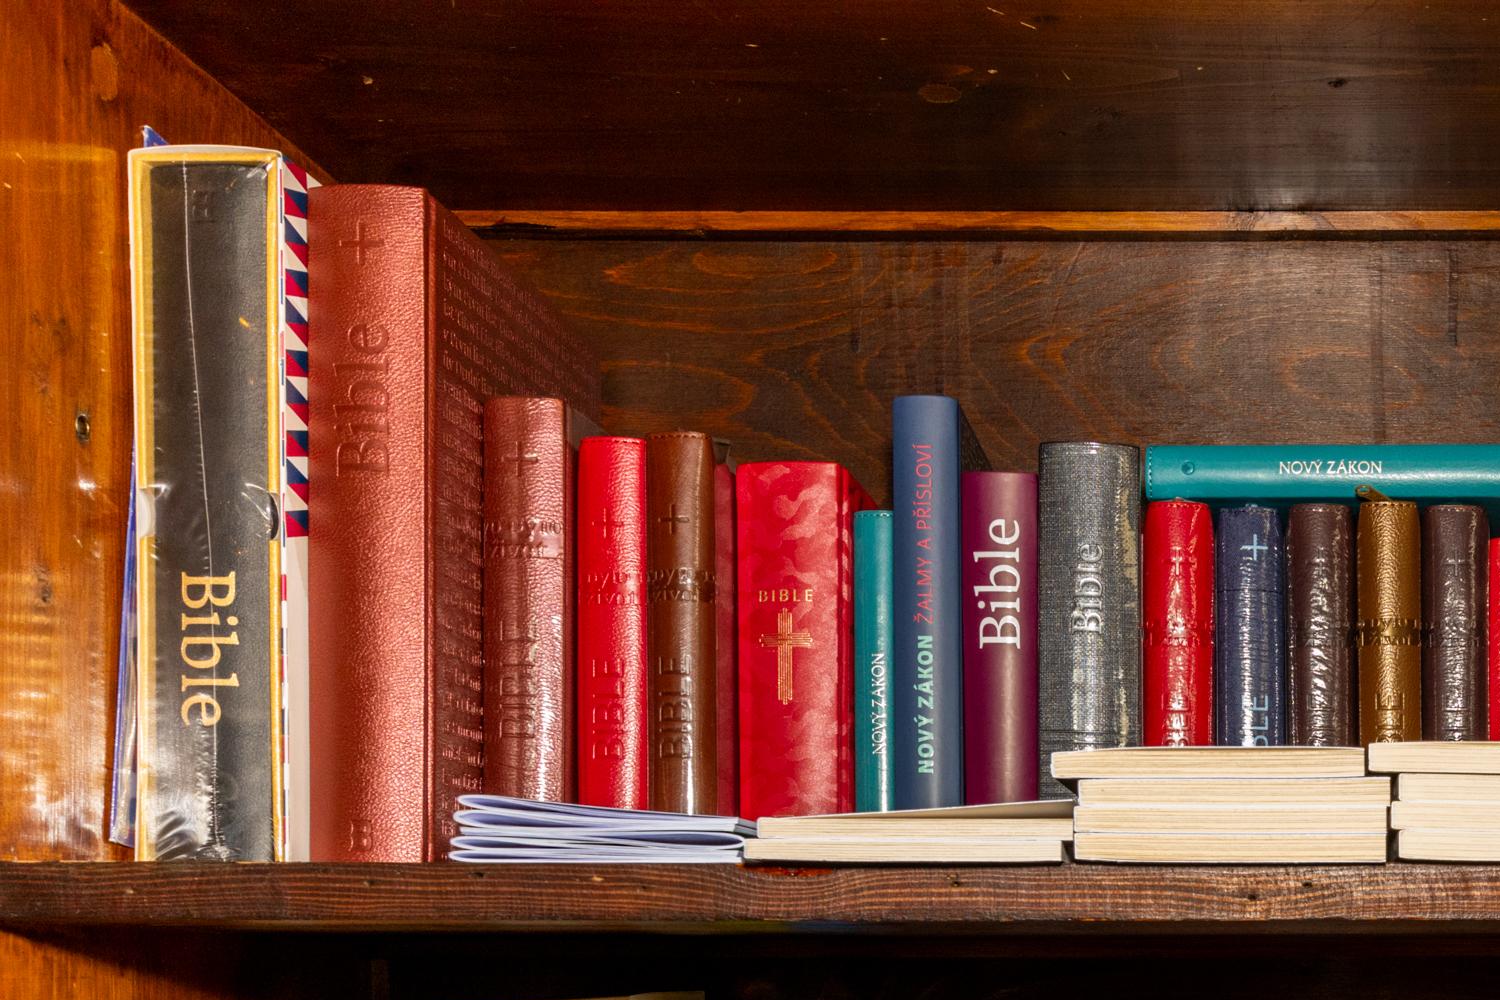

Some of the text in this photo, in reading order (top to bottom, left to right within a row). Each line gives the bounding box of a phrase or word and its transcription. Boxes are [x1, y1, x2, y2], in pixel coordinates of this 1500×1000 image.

[336, 322, 390, 476] Bible
[1279, 459, 1382, 475] NOVÝ ZÁKON
[180, 571, 239, 727] Bible
[758, 589, 814, 603] BIBLE
[911, 442, 934, 775] NOVÝ ZÁKON ŽALMY A PŘÍSLOVÍ
[973, 518, 1021, 649] Bible
[1070, 543, 1103, 633] Bible
